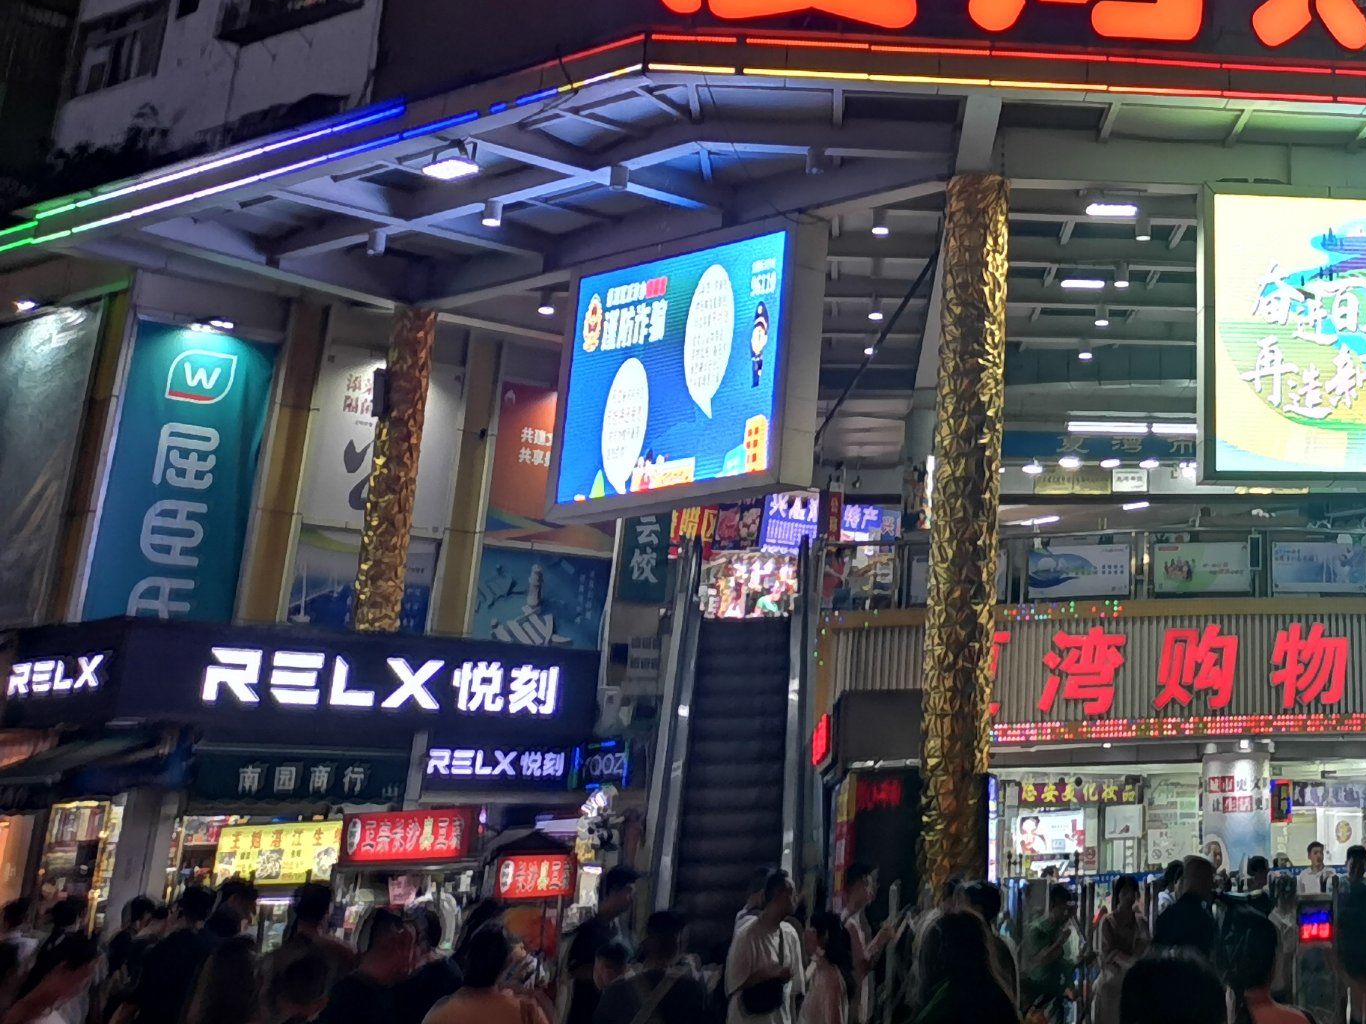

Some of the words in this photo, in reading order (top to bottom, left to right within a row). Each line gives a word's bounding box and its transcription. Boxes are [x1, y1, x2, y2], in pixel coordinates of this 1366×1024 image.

[6, 654, 104, 695] RELX
[201, 647, 446, 711] RELX
[453, 663, 560, 715] 悦刻
[239, 764, 365, 794] 南园商行
[428, 749, 515, 775] RELX
[520, 752, 565, 777] 悦刻
